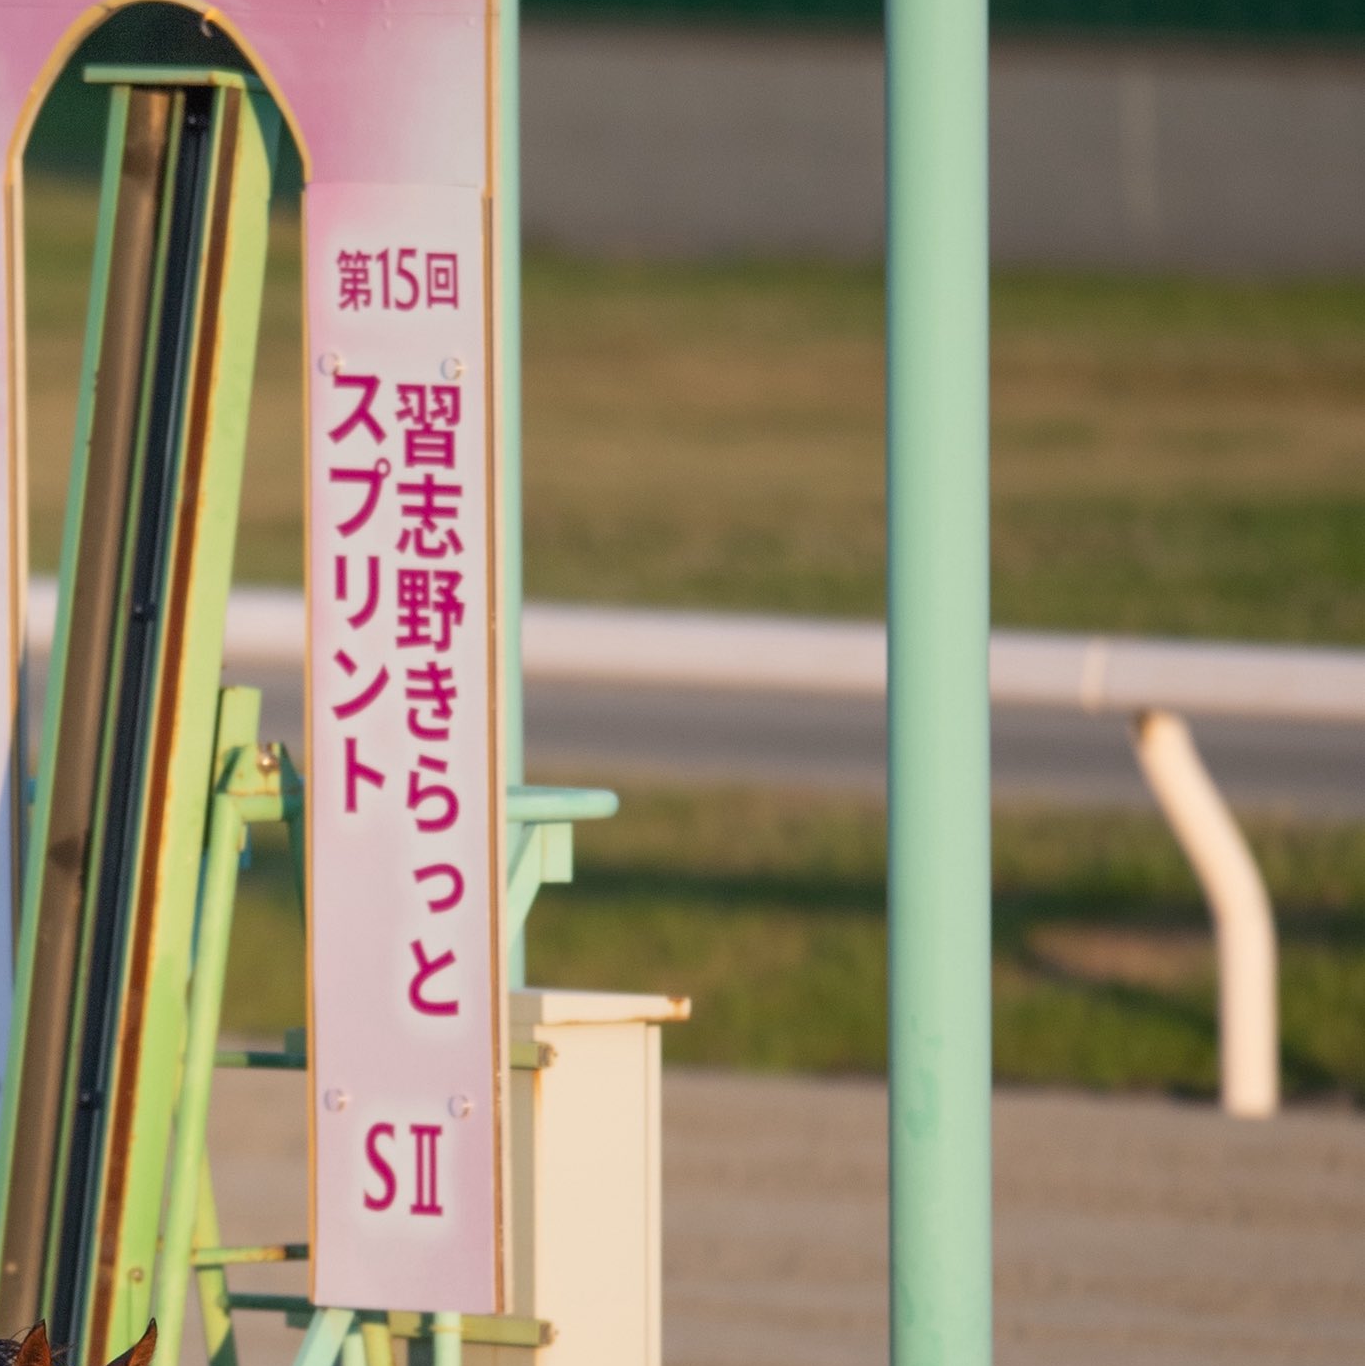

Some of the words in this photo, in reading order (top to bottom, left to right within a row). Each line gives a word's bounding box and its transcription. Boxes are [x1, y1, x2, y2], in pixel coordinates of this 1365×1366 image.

[336, 247, 459, 312] 第15回
[328, 372, 391, 814] スプリント
[396, 383, 466, 1017] 習志野きらっと
